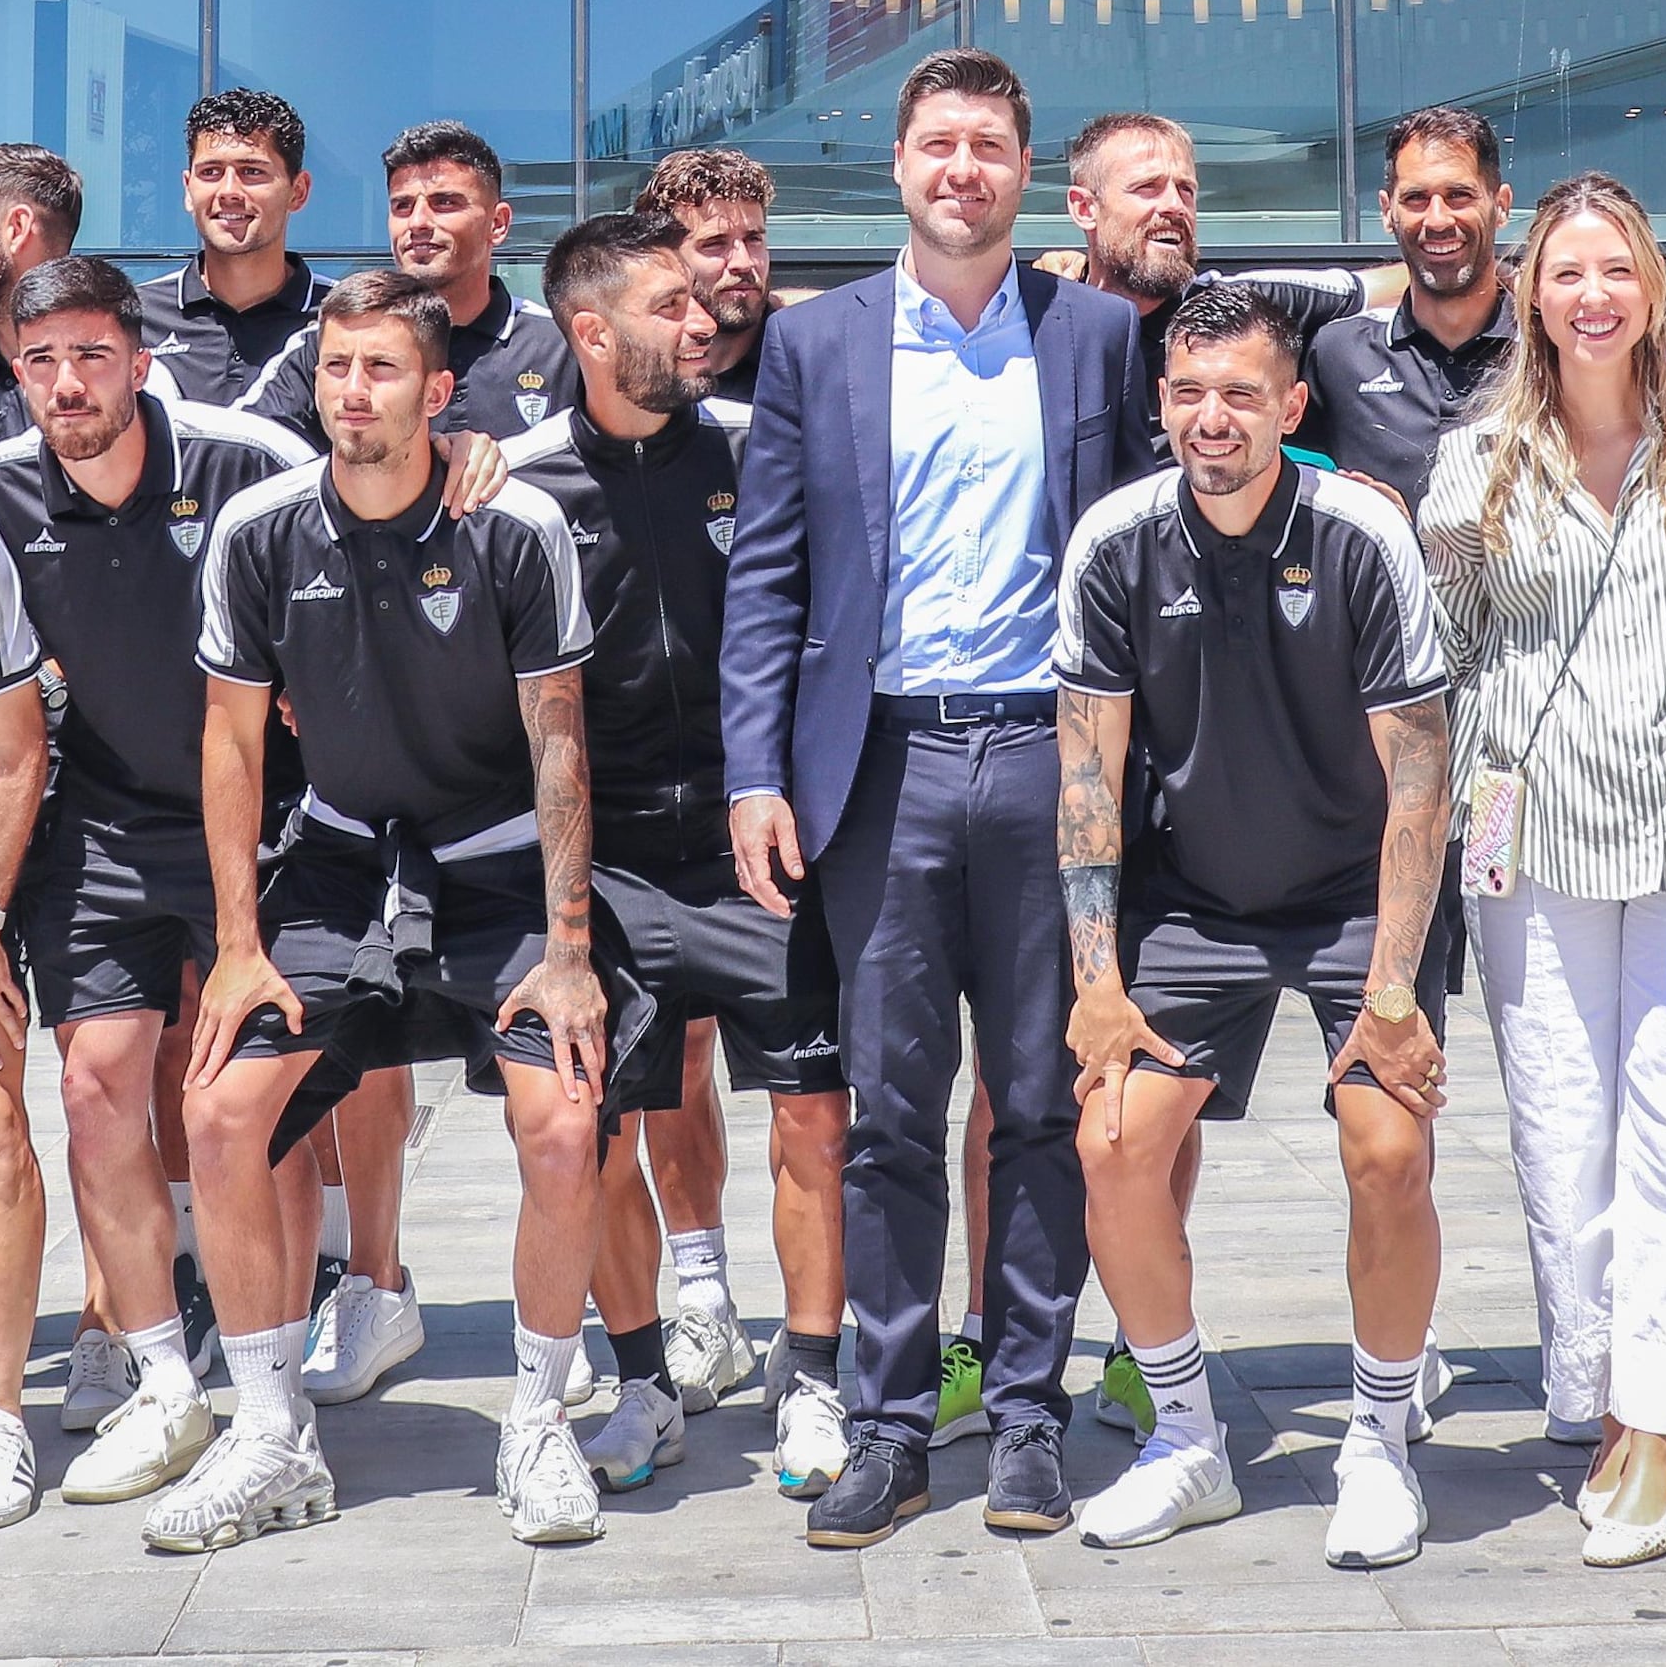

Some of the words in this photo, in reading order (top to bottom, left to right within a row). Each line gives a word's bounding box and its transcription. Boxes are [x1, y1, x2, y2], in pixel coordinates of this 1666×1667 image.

[23, 542, 67, 553] MERCURY
[291, 587, 345, 601] MERCURY
[1159, 603, 1202, 617] MERCU
